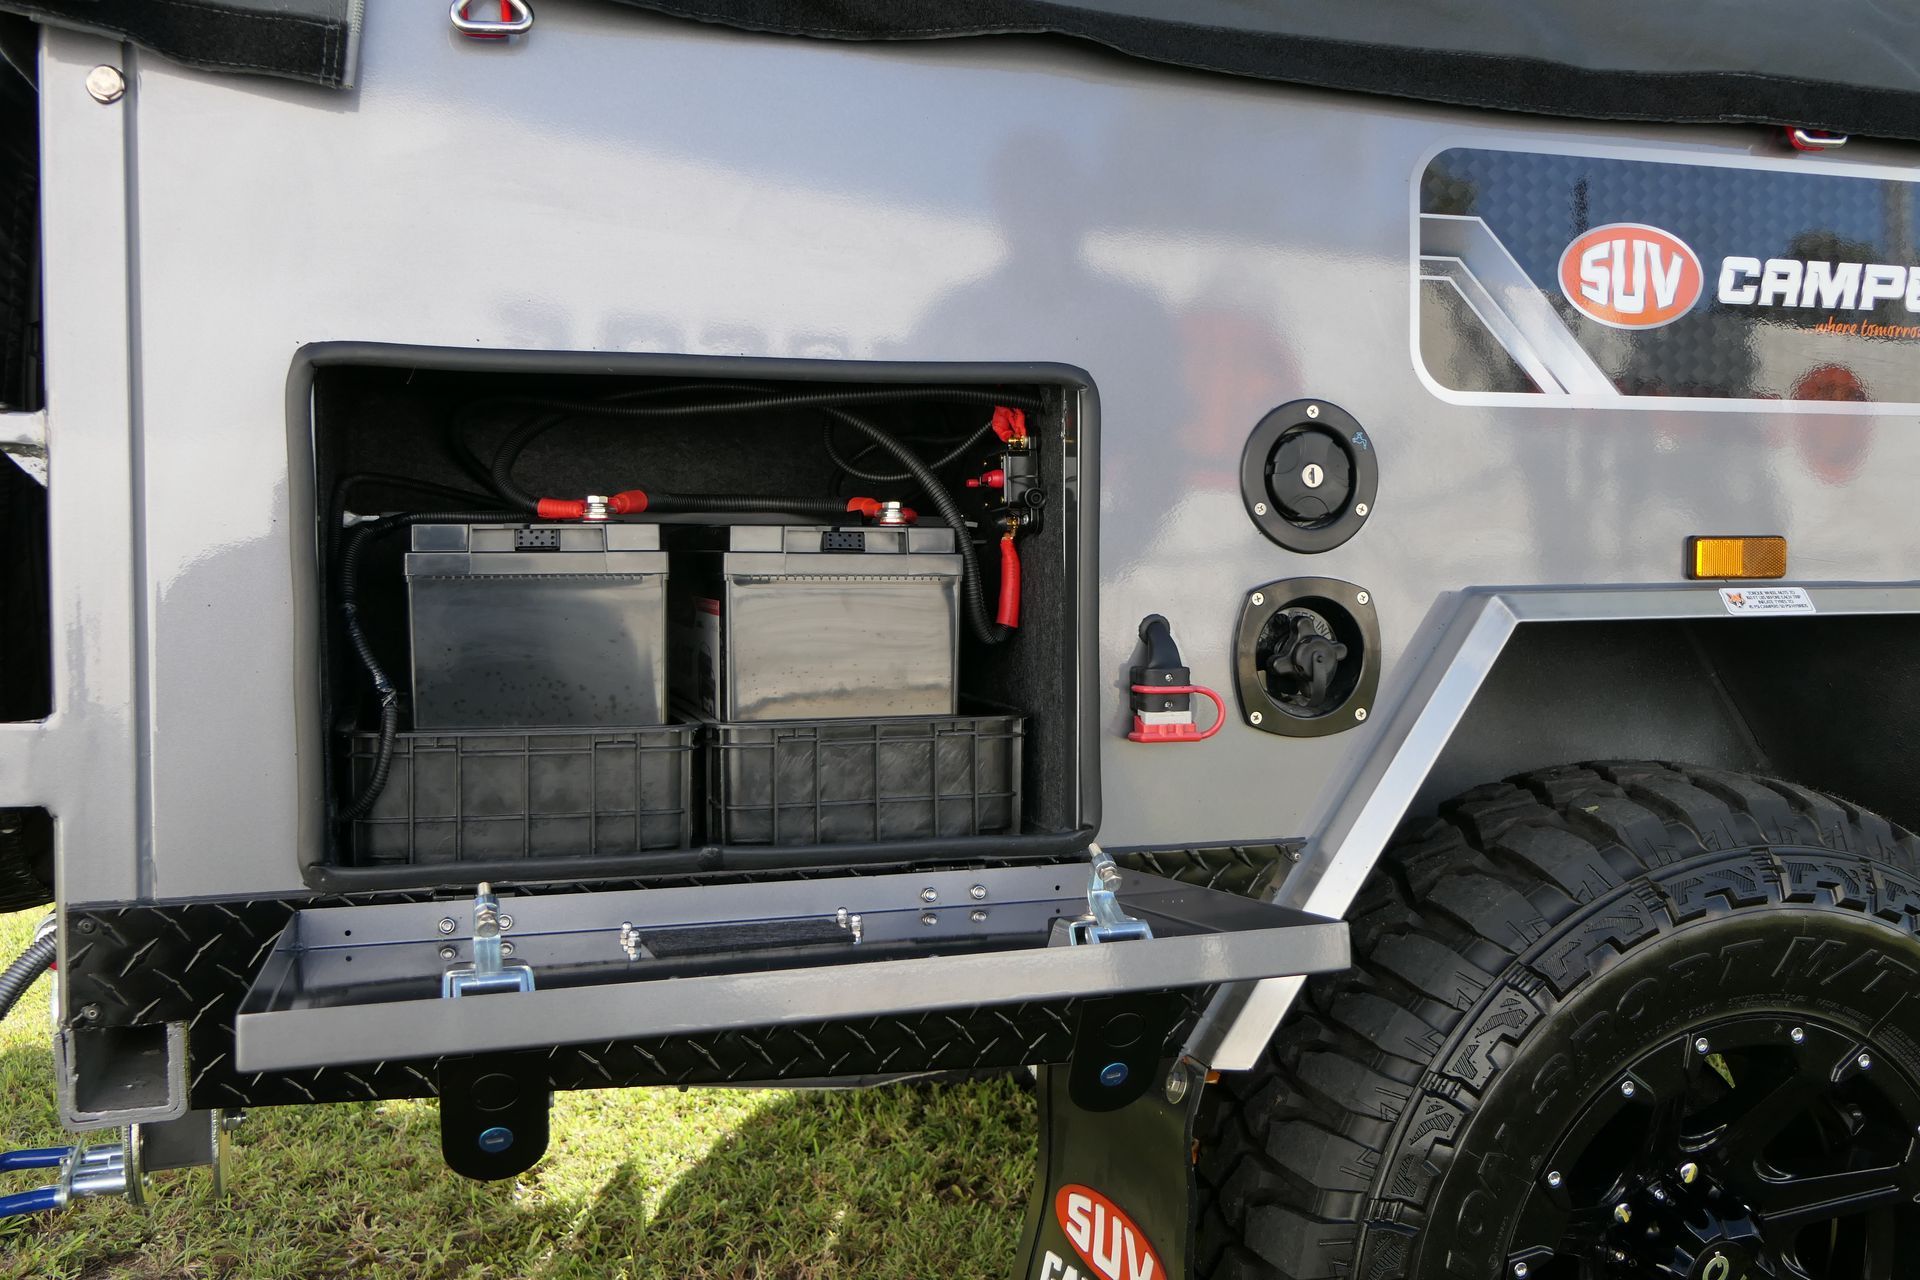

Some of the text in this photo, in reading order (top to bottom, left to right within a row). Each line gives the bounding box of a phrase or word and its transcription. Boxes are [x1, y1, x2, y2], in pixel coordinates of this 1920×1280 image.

[1579, 239, 1684, 315] SUV
[1861, 319, 1920, 338] tomorro
[1066, 1192, 1154, 1280] SUV
